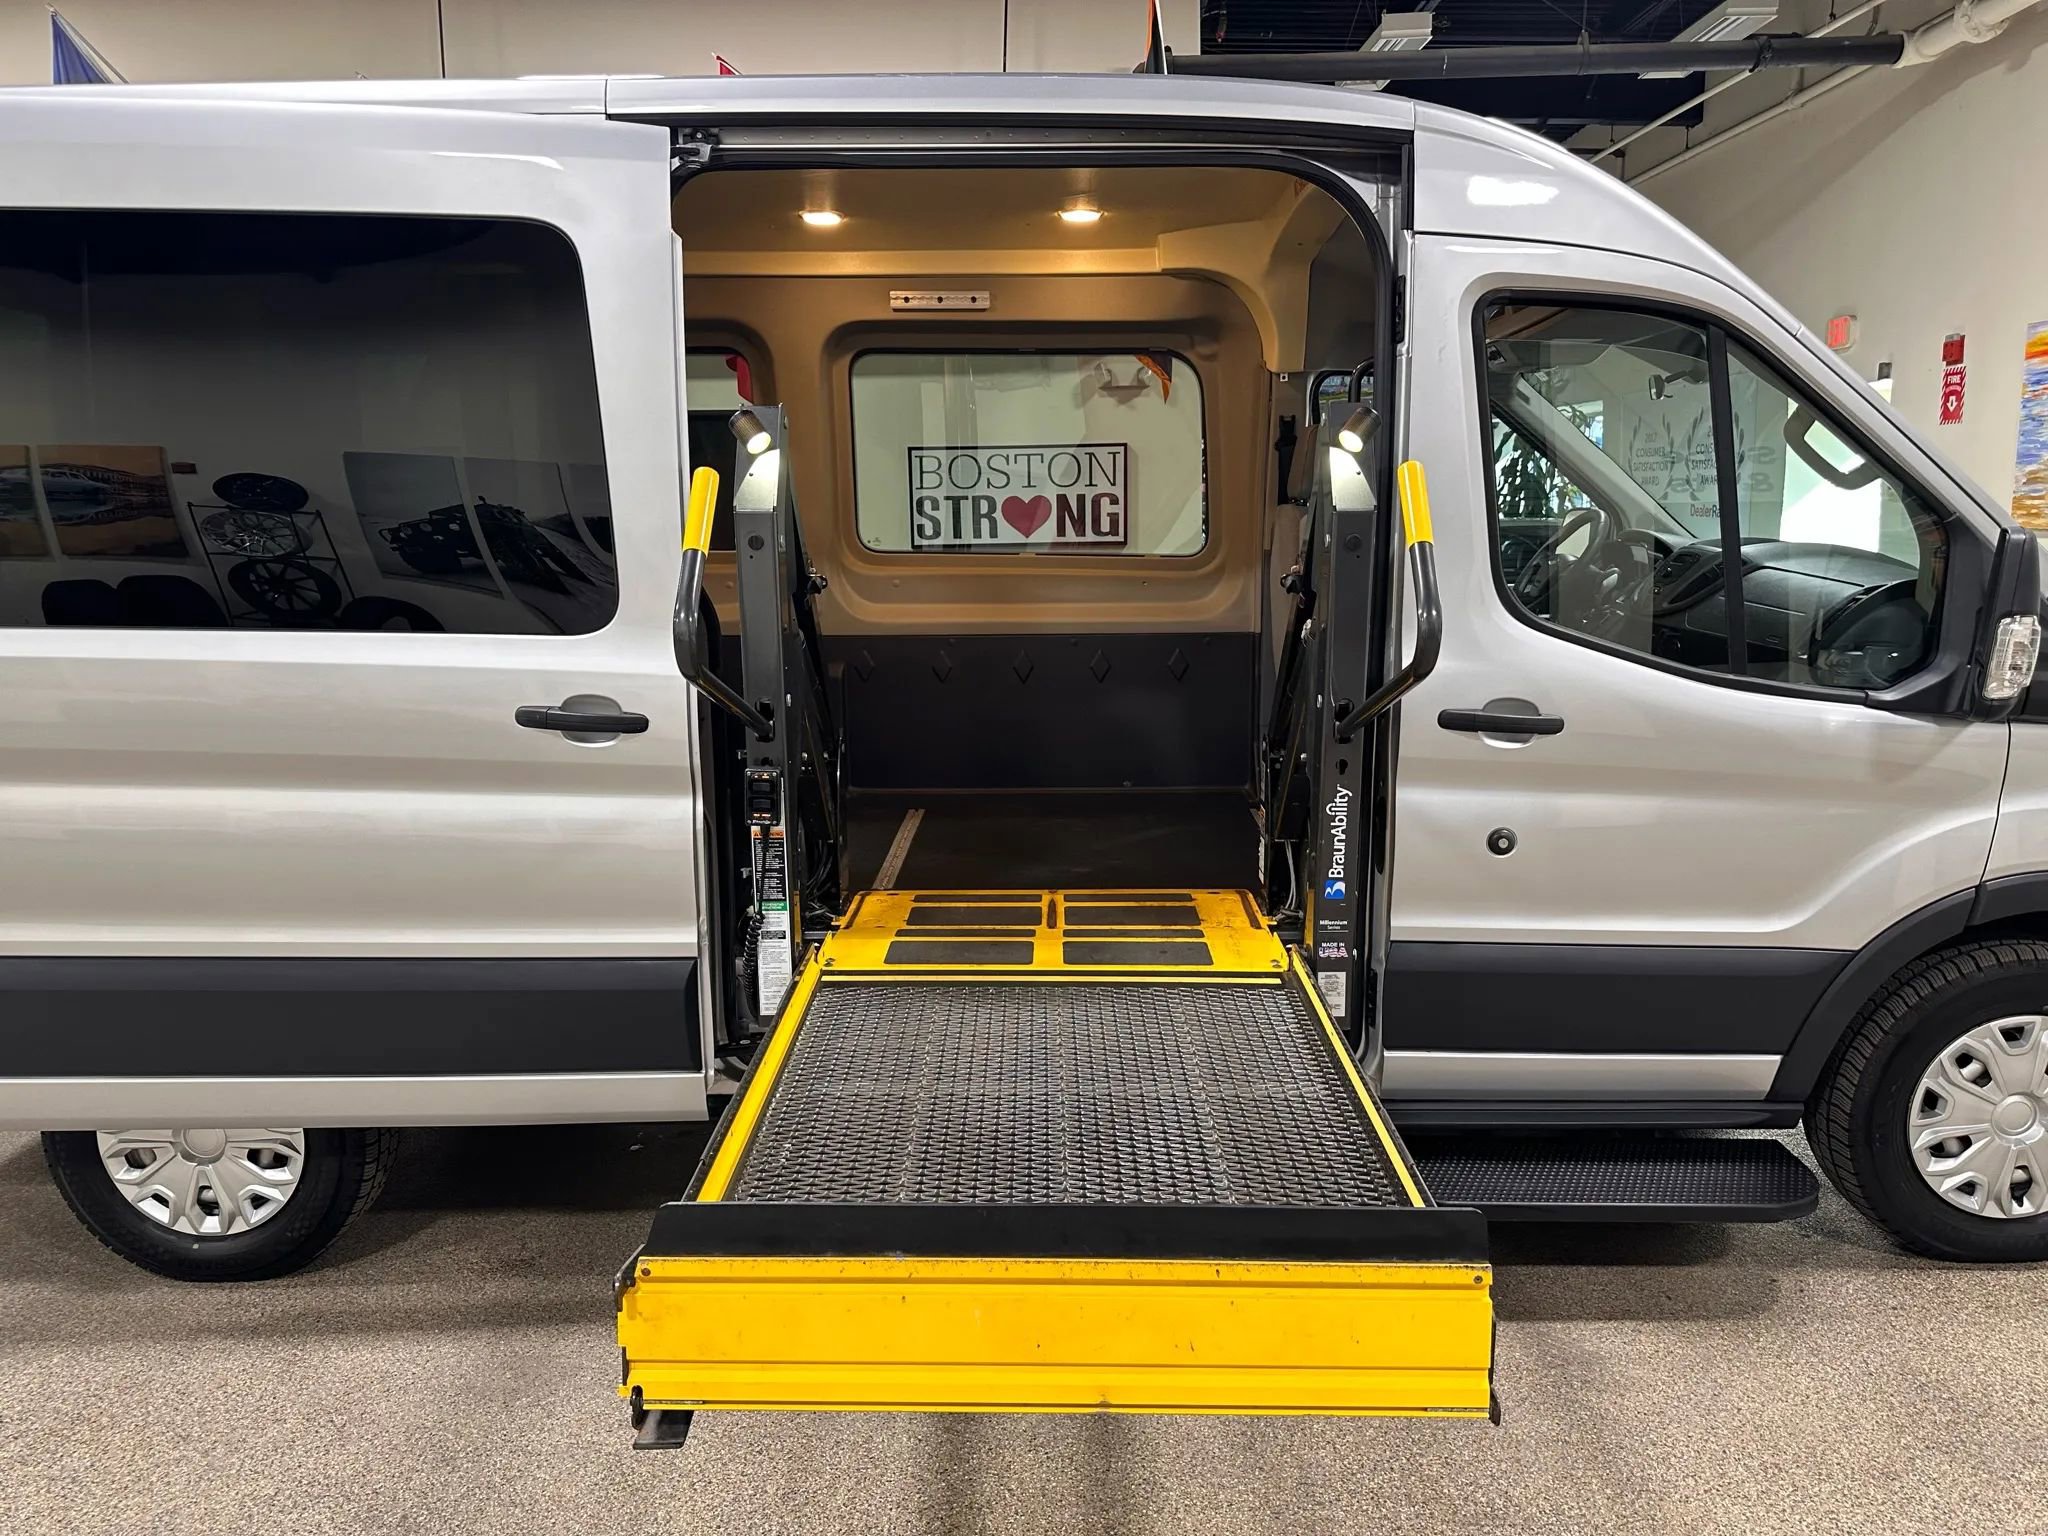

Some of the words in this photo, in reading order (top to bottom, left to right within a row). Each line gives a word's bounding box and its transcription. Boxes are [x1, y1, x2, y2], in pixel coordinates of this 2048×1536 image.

[1947, 374, 1962, 384] FIRE
[1635, 446, 1666, 458] CONSUMER
[1695, 443, 1715, 455] CONS
[914, 451, 1121, 490] BOSTON
[1632, 460, 1669, 472] SATISFACTION
[1691, 459, 1717, 471] SATISFA
[1700, 474, 1718, 486] AWAR
[1690, 504, 1721, 518] DealerRa
[1325, 786, 1353, 878] BraunAbility
[1318, 947, 1349, 958] USA
